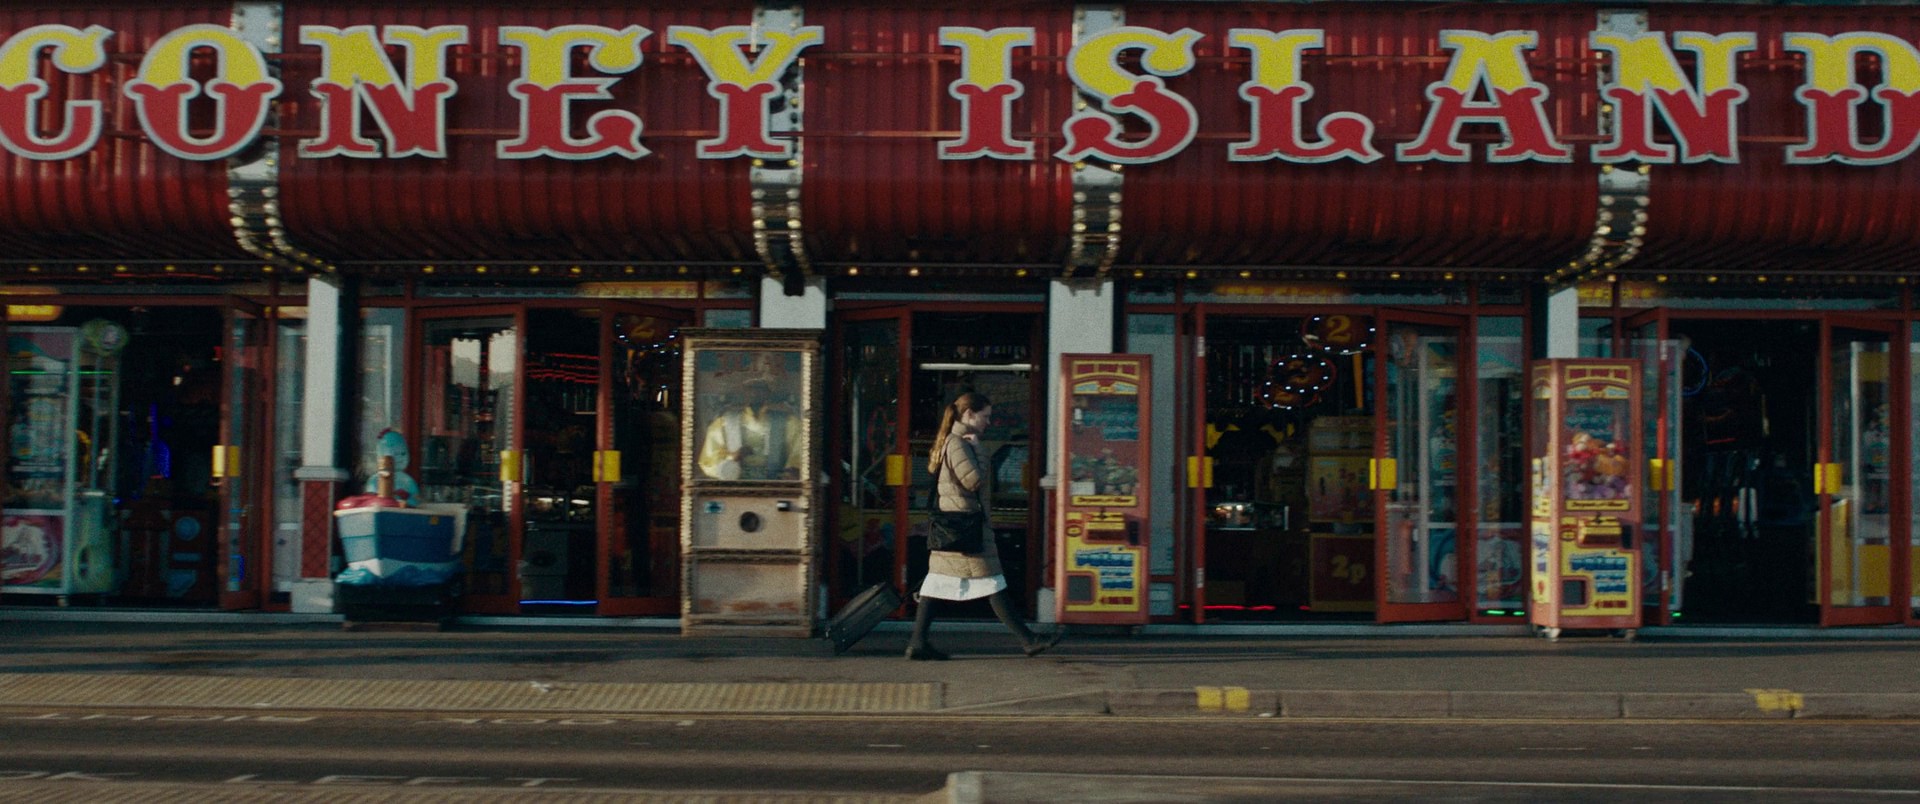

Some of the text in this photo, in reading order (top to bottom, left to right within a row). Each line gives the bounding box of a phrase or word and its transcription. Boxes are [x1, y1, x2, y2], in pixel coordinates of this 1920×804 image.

[0, 24, 1920, 165] CONEY ISLAND
[1326, 314, 1353, 342] 2
[1330, 554, 1367, 585] 2p
[224, 773, 582, 787] LEFT
